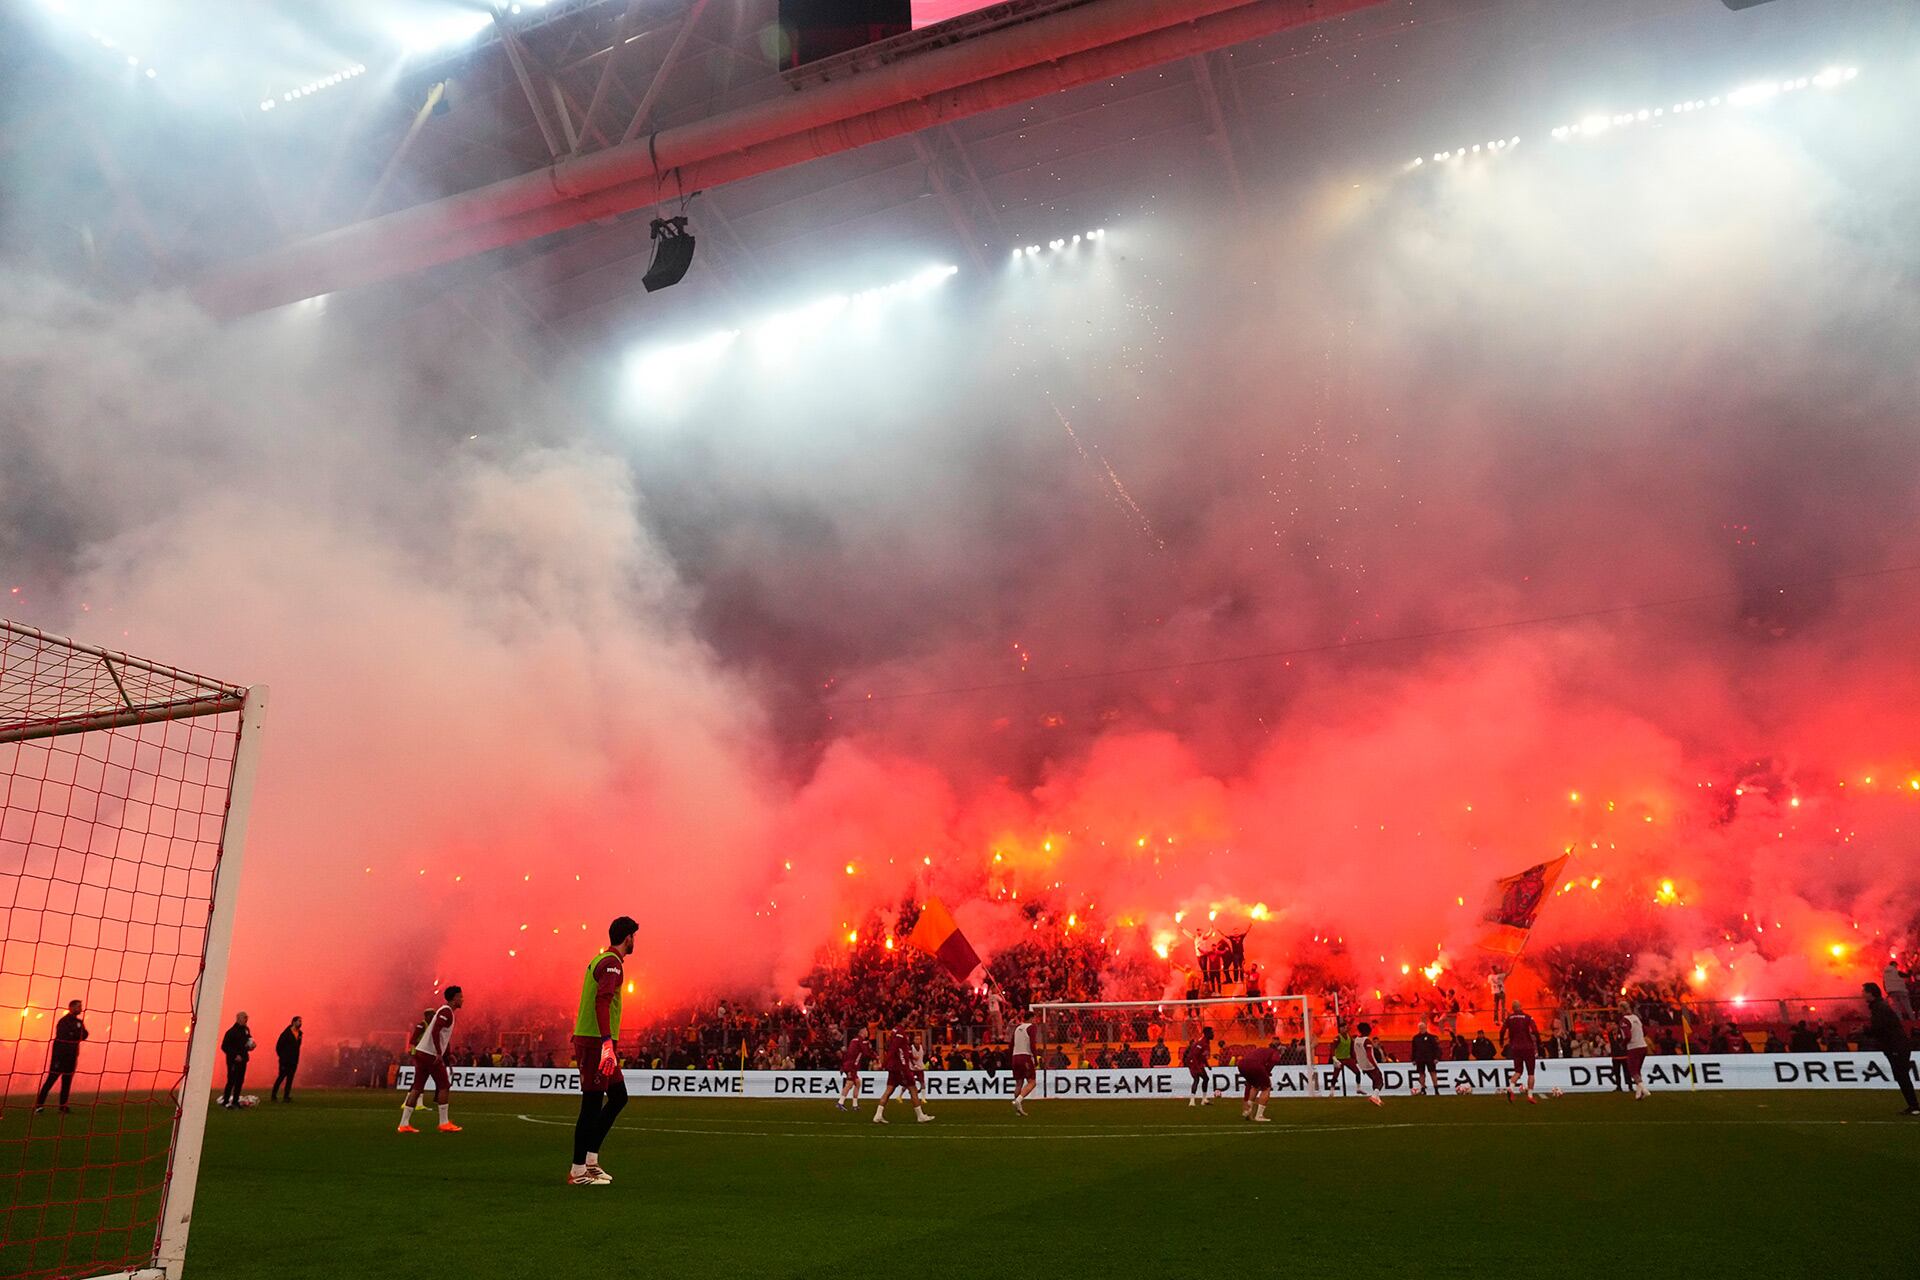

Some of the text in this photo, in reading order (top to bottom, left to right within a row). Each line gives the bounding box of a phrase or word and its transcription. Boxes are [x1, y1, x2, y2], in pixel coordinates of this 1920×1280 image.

[450, 1072, 515, 1088] REAME
[540, 1074, 580, 1090] DRE
[651, 1075, 744, 1093] DREAME
[774, 1077, 875, 1094] DREAE
[916, 1077, 1016, 1094] REAME
[1054, 1074, 1172, 1094] DREAME
[1212, 1072, 1341, 1092] DRAME
[1569, 1063, 1723, 1086] DRAME
